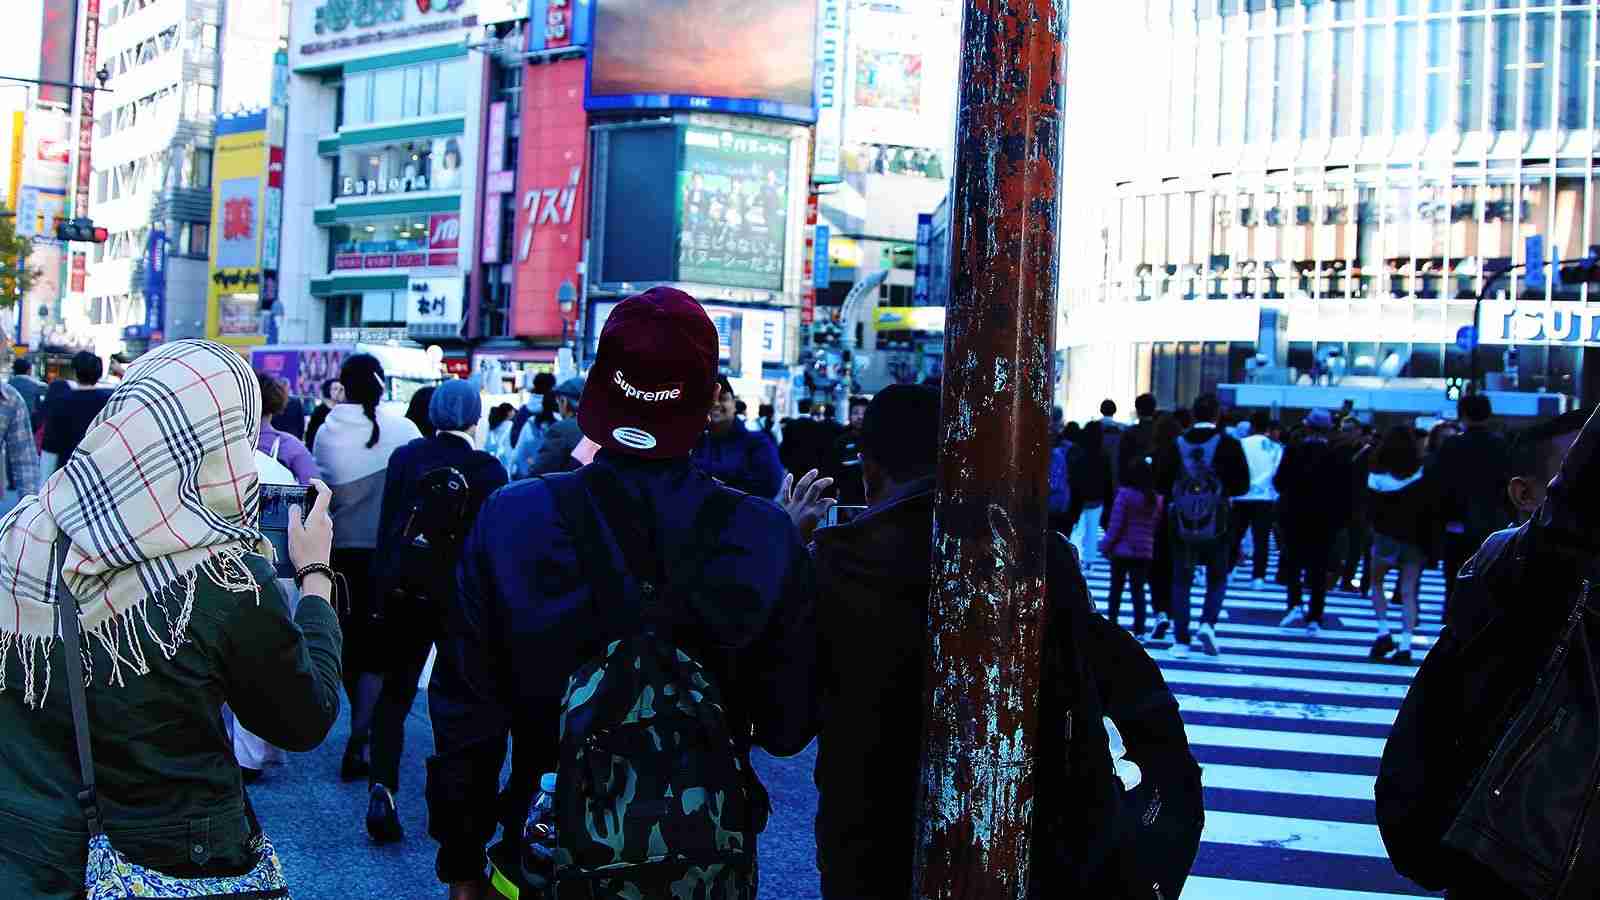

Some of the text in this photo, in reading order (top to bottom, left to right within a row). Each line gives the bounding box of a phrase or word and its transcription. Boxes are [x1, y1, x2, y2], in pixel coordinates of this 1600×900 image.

[517, 166, 582, 262] クスリ
[430, 219, 459, 246] JTB
[613, 369, 681, 402] Supreme
